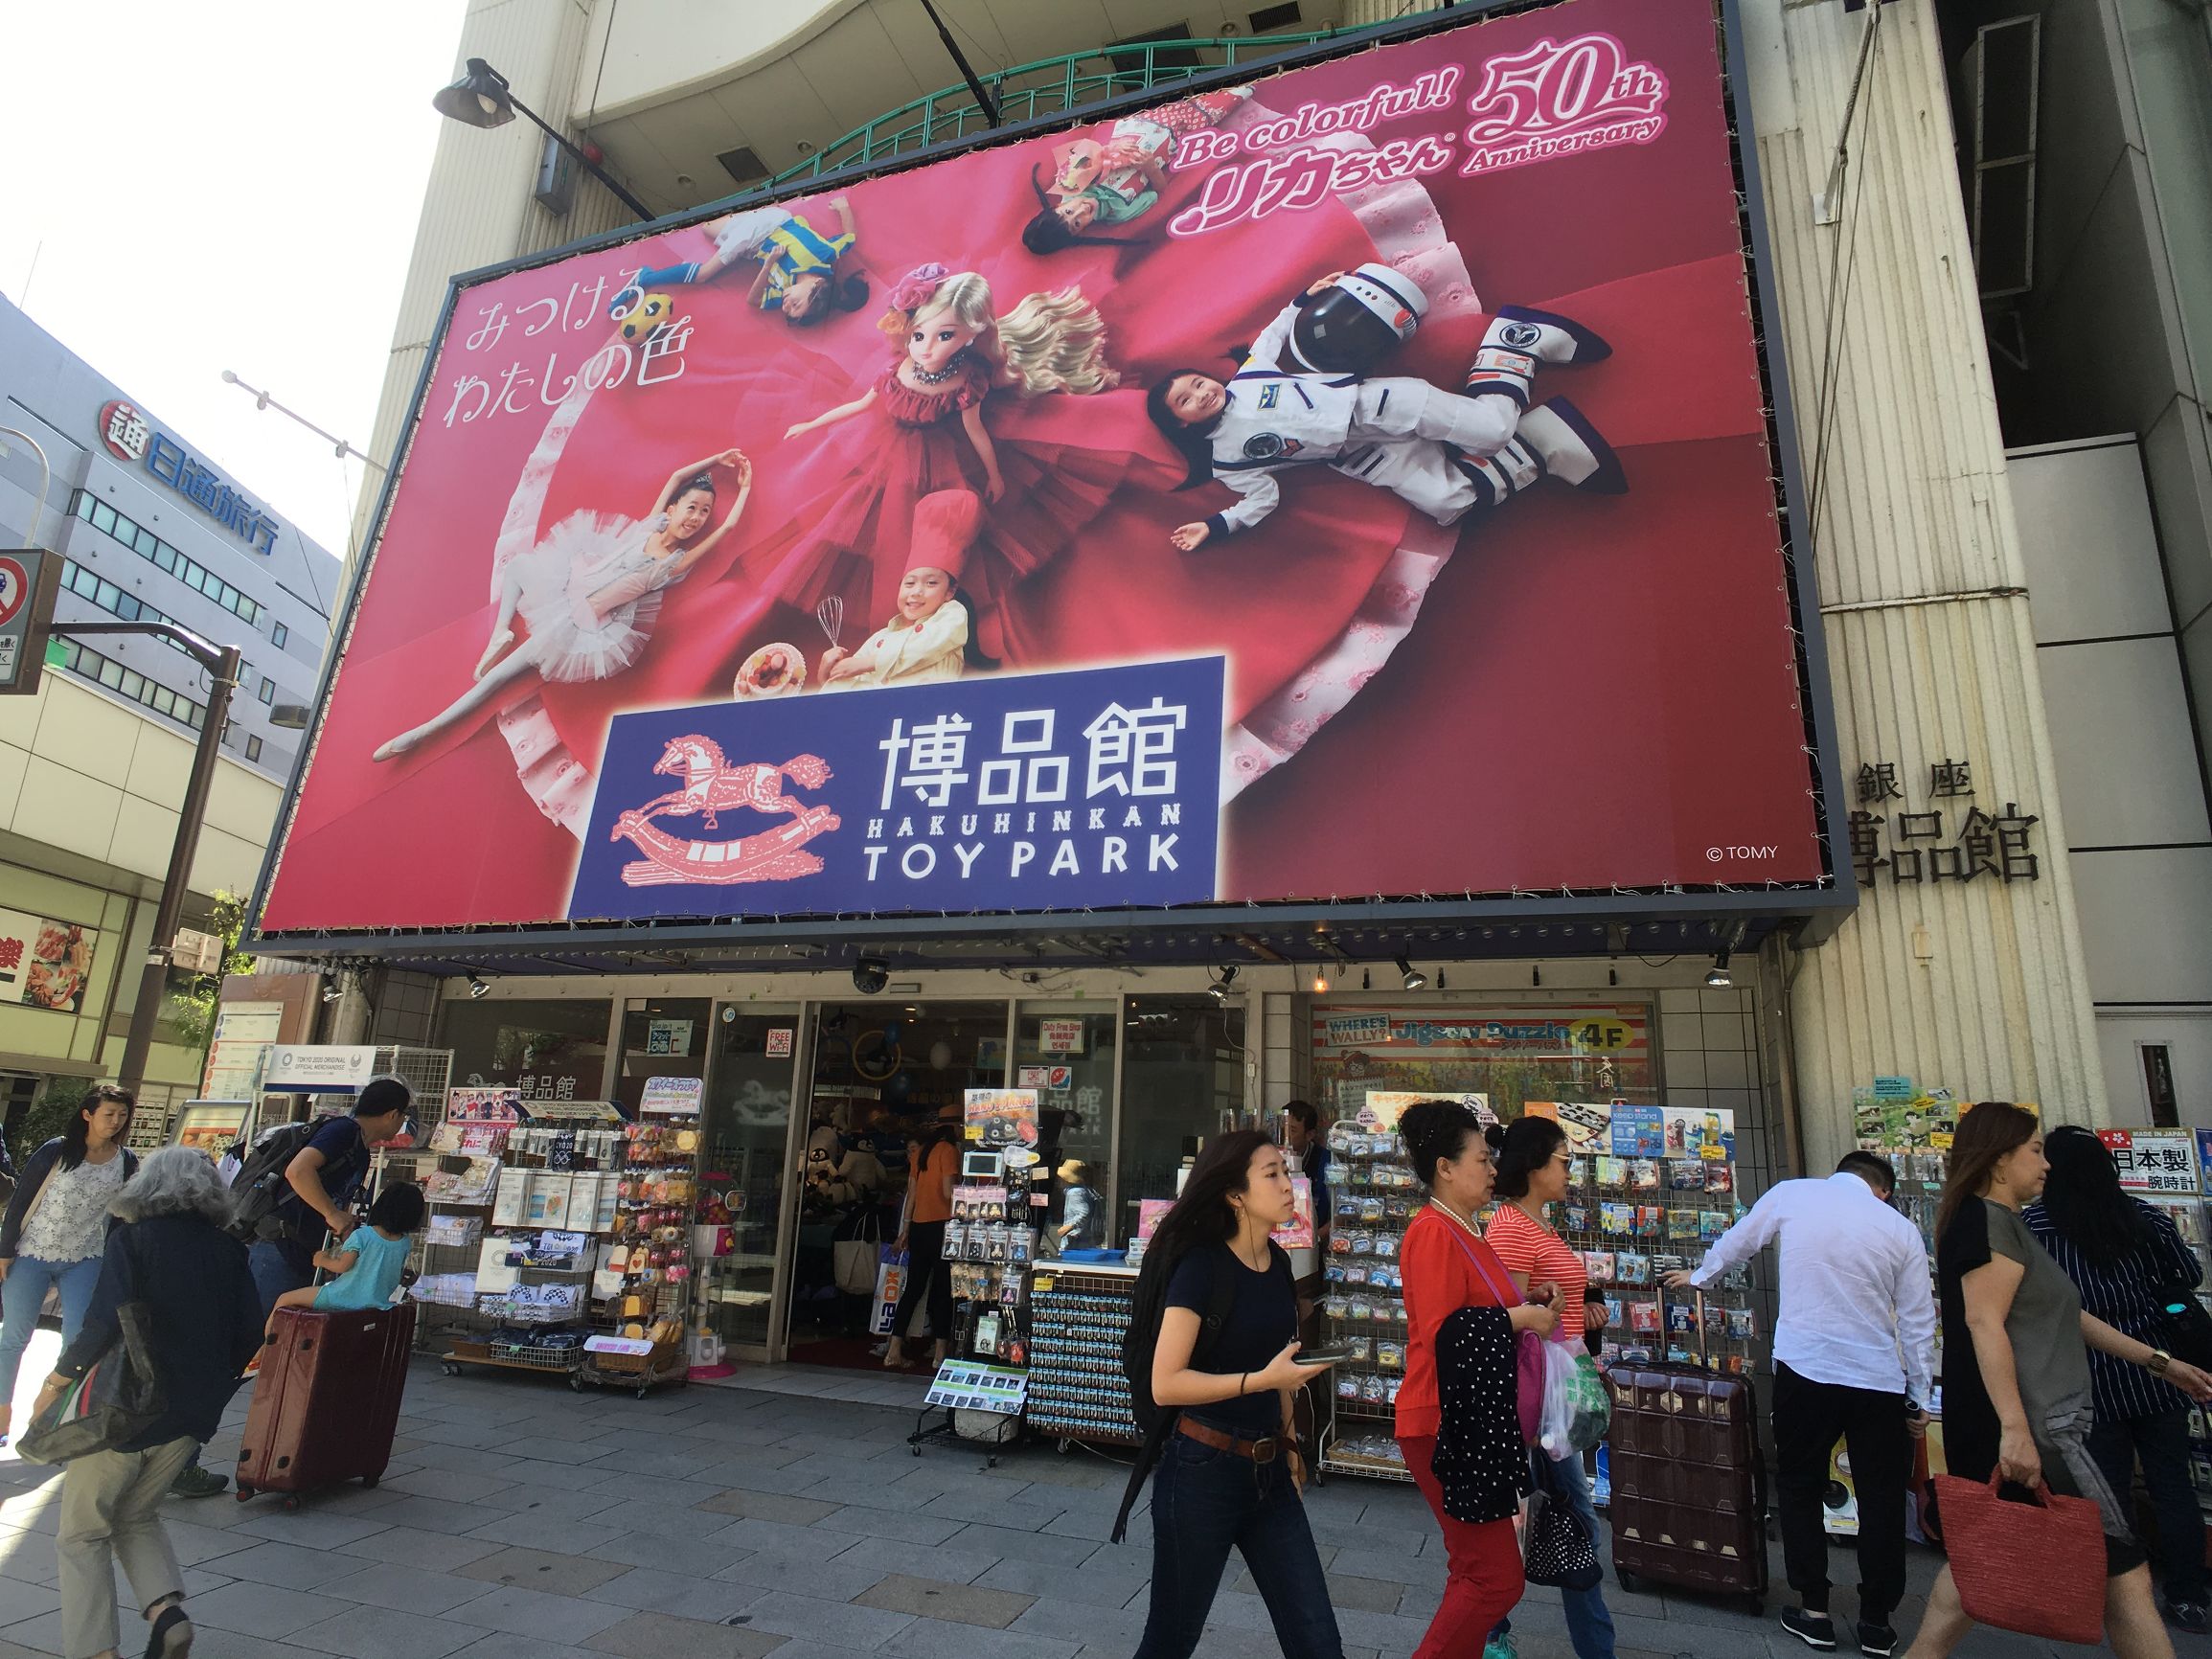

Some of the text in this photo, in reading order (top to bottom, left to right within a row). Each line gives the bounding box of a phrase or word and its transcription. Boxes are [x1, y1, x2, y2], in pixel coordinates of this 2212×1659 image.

[1468, 35, 1663, 145] 50th
[1174, 66, 1459, 170] Be colorful!
[1463, 116, 1662, 174] Anniversary
[1170, 136, 1451, 236] リカちゃん
[443, 314, 696, 428] わたしの色
[147, 431, 280, 557] 日通旅行
[878, 696, 1188, 811] 博品館
[1856, 758, 1976, 804] 銀座
[866, 803, 1181, 839] HAKUHINKAN
[863, 832, 1180, 881] TOY PARK
[1727, 845, 1779, 860] TOMY
[769, 1032, 790, 1042] FREE
[1329, 1016, 1387, 1033] WHERE'S
[1330, 1029, 1386, 1044] WALLY?
[1396, 1021, 1571, 1047] Jigsaw Puzzle
[769, 1042, 789, 1052] Wi-Fi
[515, 1074, 577, 1101] 博品館
[2112, 1148, 2192, 1172] 日本製
[2147, 1174, 2196, 1191] 腕時計
